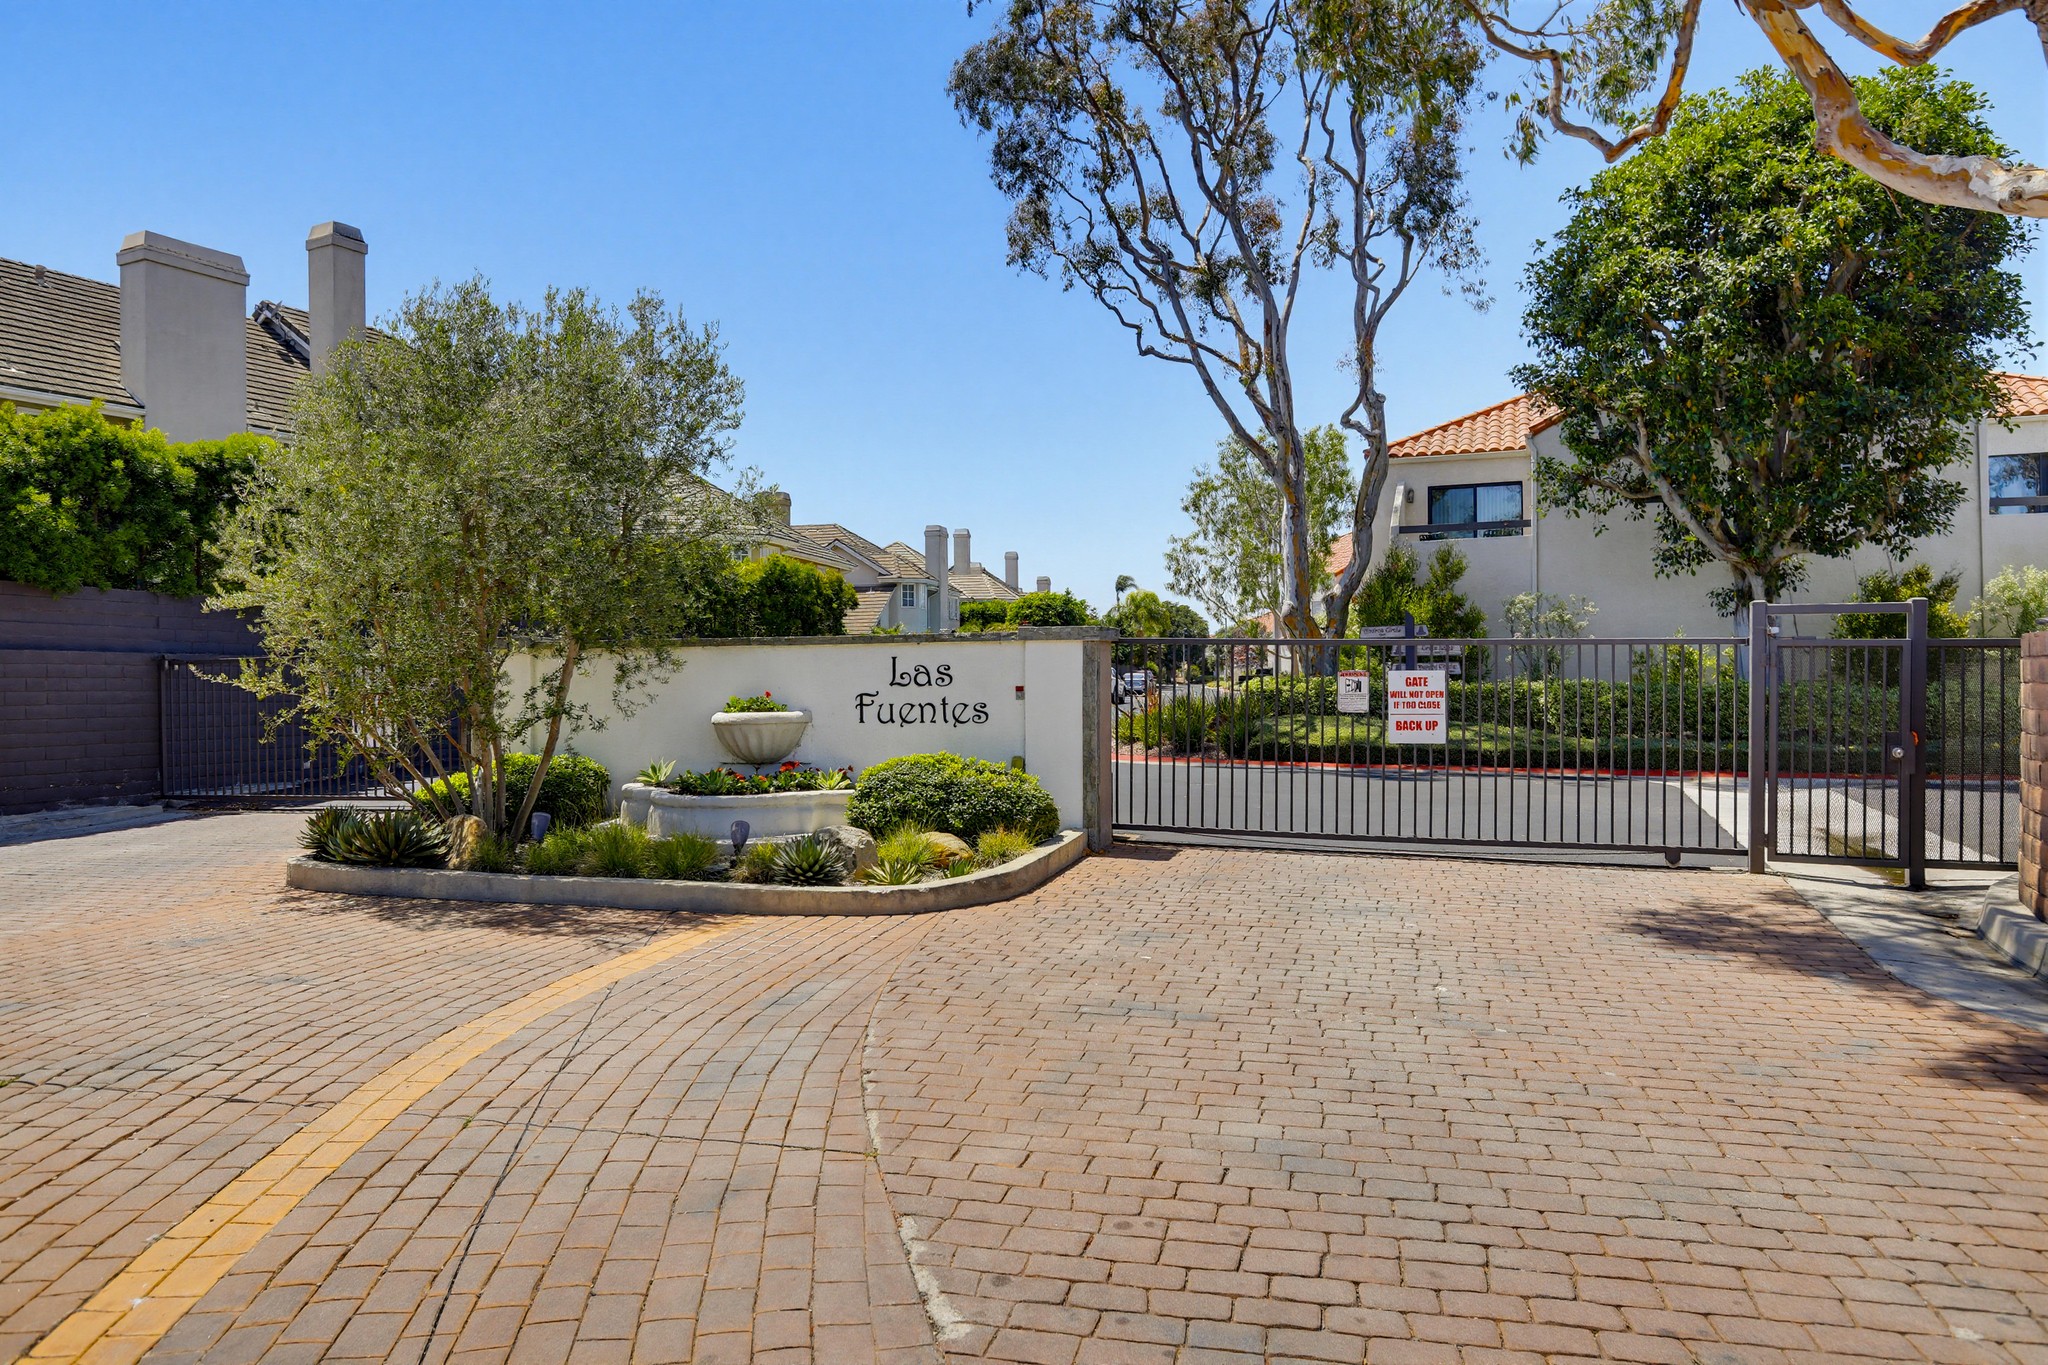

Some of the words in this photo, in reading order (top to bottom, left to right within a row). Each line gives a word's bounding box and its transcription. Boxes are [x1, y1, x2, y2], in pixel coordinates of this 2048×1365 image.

[889, 656, 953, 687] Las
[1405, 676, 1428, 687] GATE
[1390, 690, 1407, 698] WILL
[1409, 690, 1423, 698] NOT
[1425, 690, 1444, 698] OPEN
[855, 691, 989, 728] Fuentes
[1393, 701, 1400, 709] IF
[1402, 701, 1416, 709] TOO
[1418, 701, 1441, 709] CLOSE
[1395, 720, 1422, 731] BACK
[1425, 720, 1438, 731] UP
